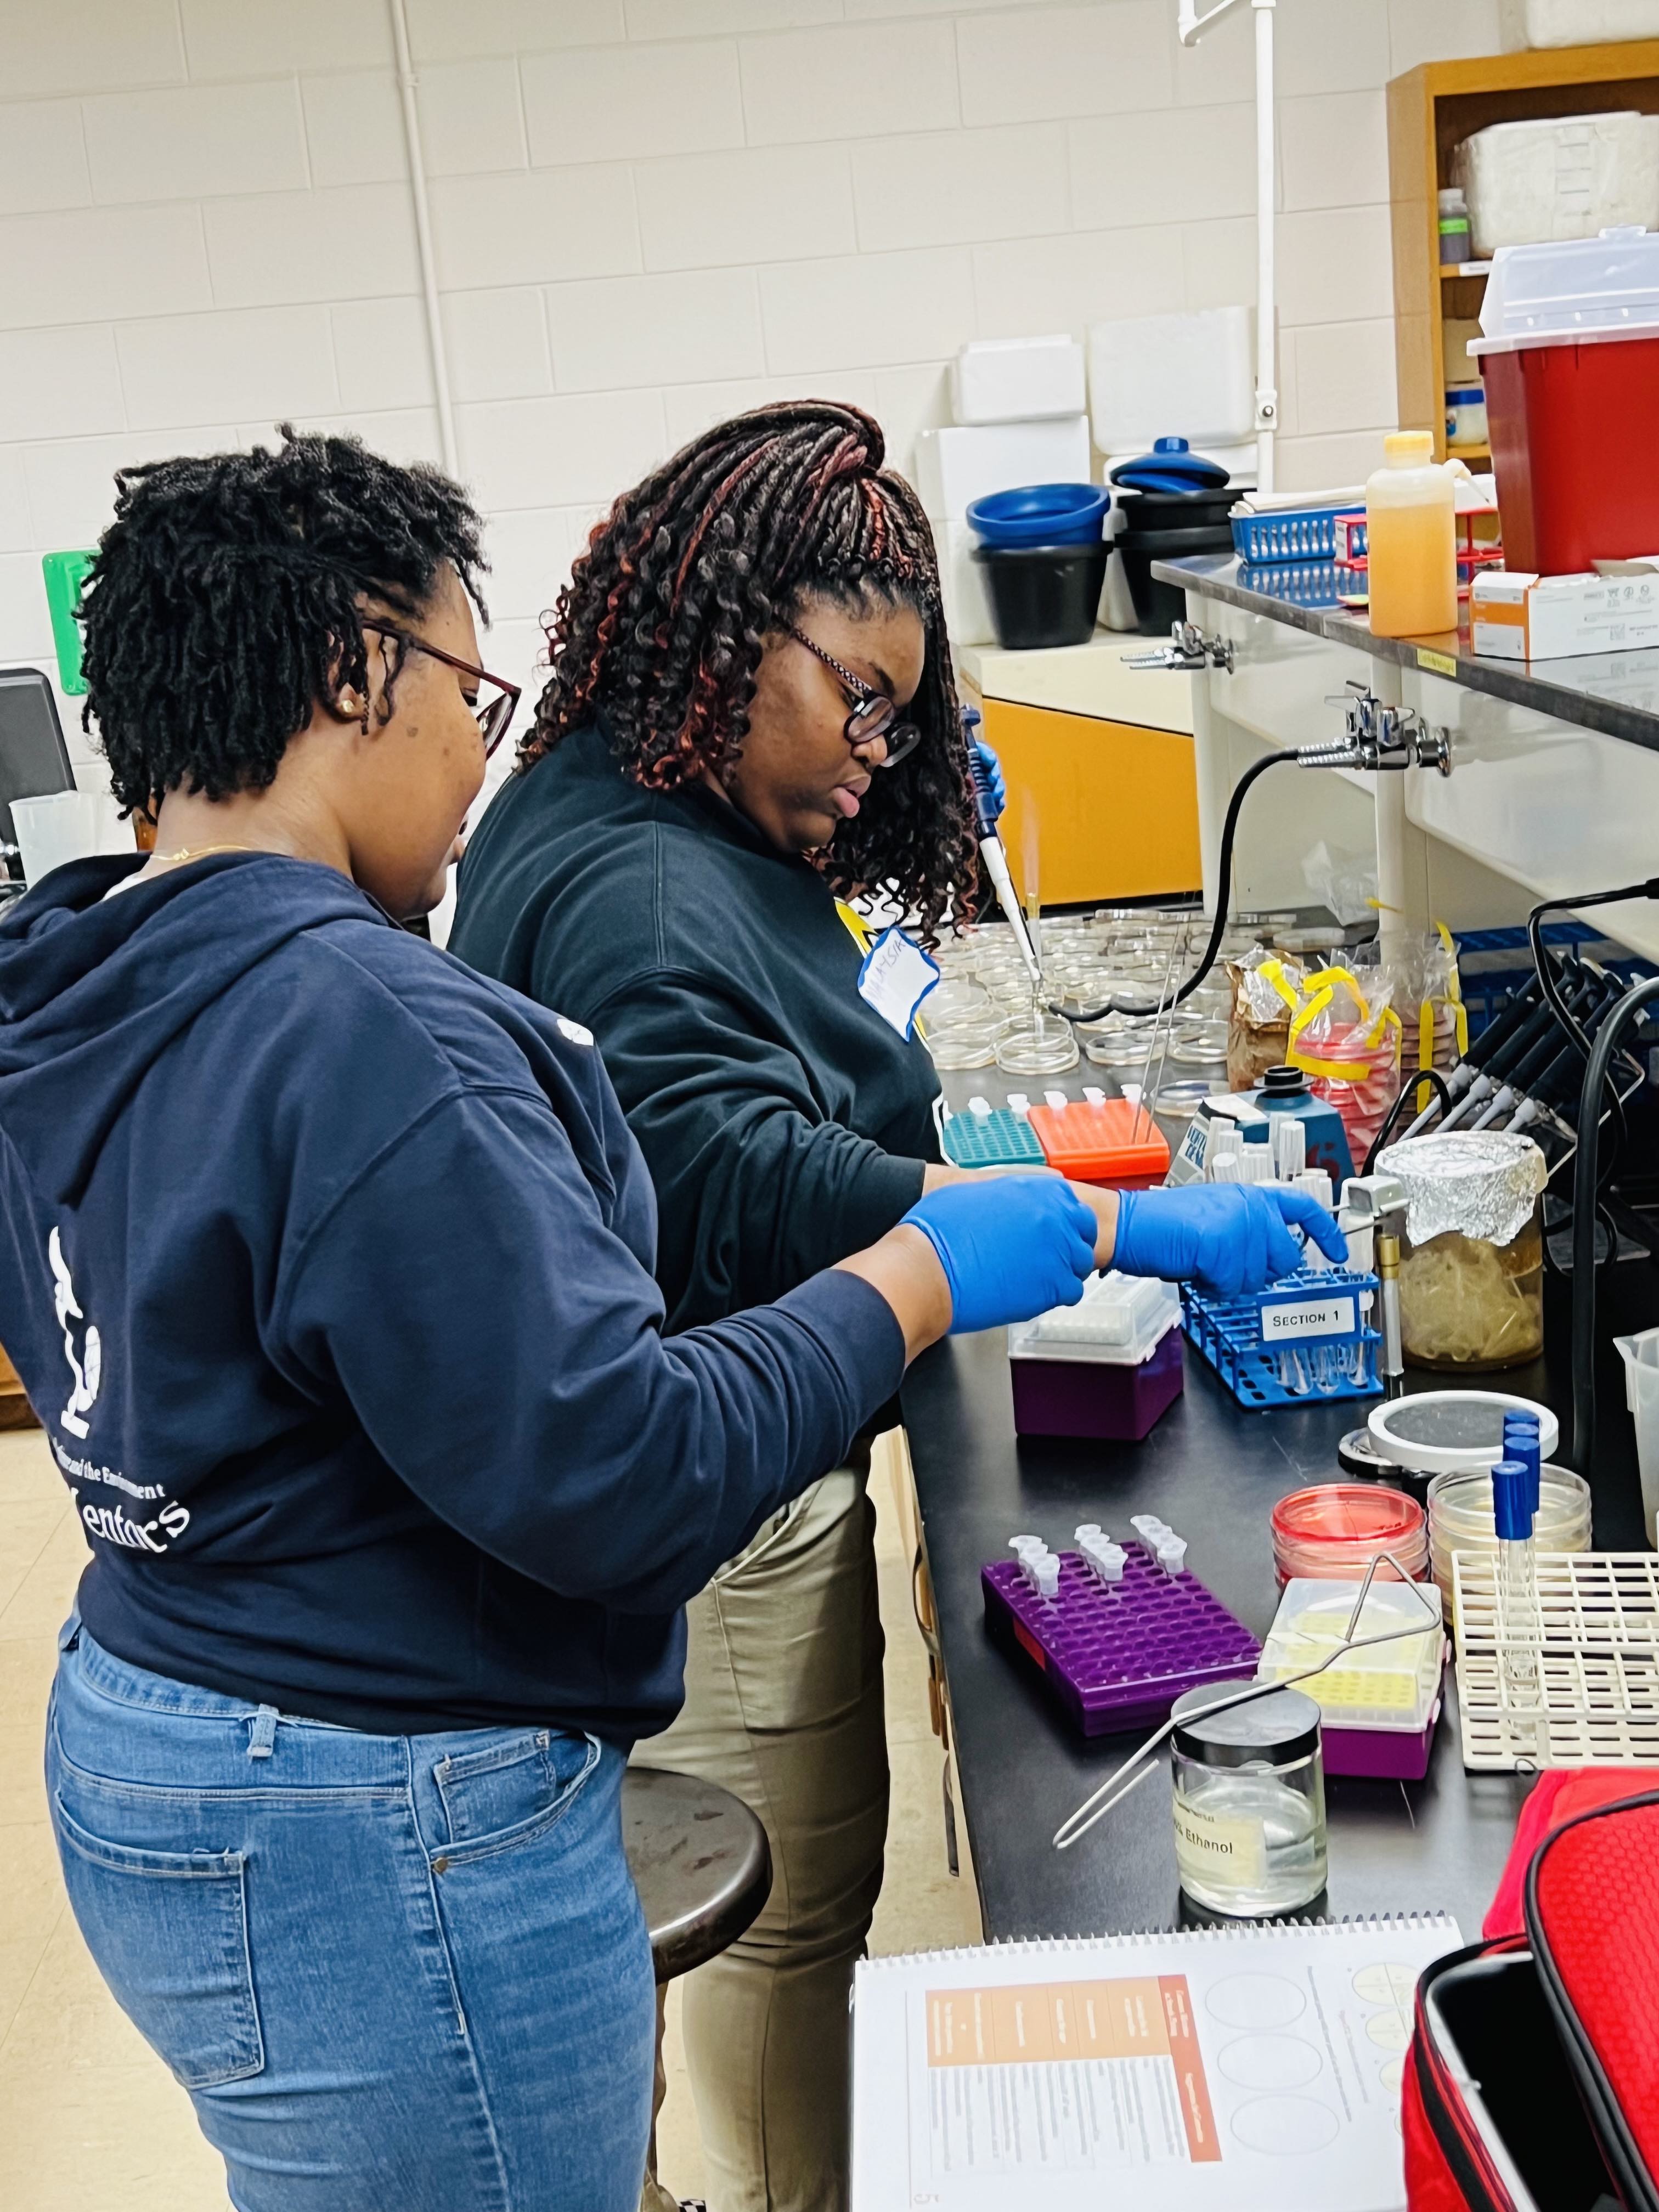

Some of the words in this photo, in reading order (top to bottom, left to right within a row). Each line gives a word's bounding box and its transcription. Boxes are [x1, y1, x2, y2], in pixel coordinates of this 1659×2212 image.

[1273, 1313, 1325, 1327] SECTION
[1333, 1310, 1339, 1321] 1
[84, 1461, 101, 1481] the
[71, 1487, 190, 1553] entors
[1186, 1827, 1233, 1854] Ethanol
